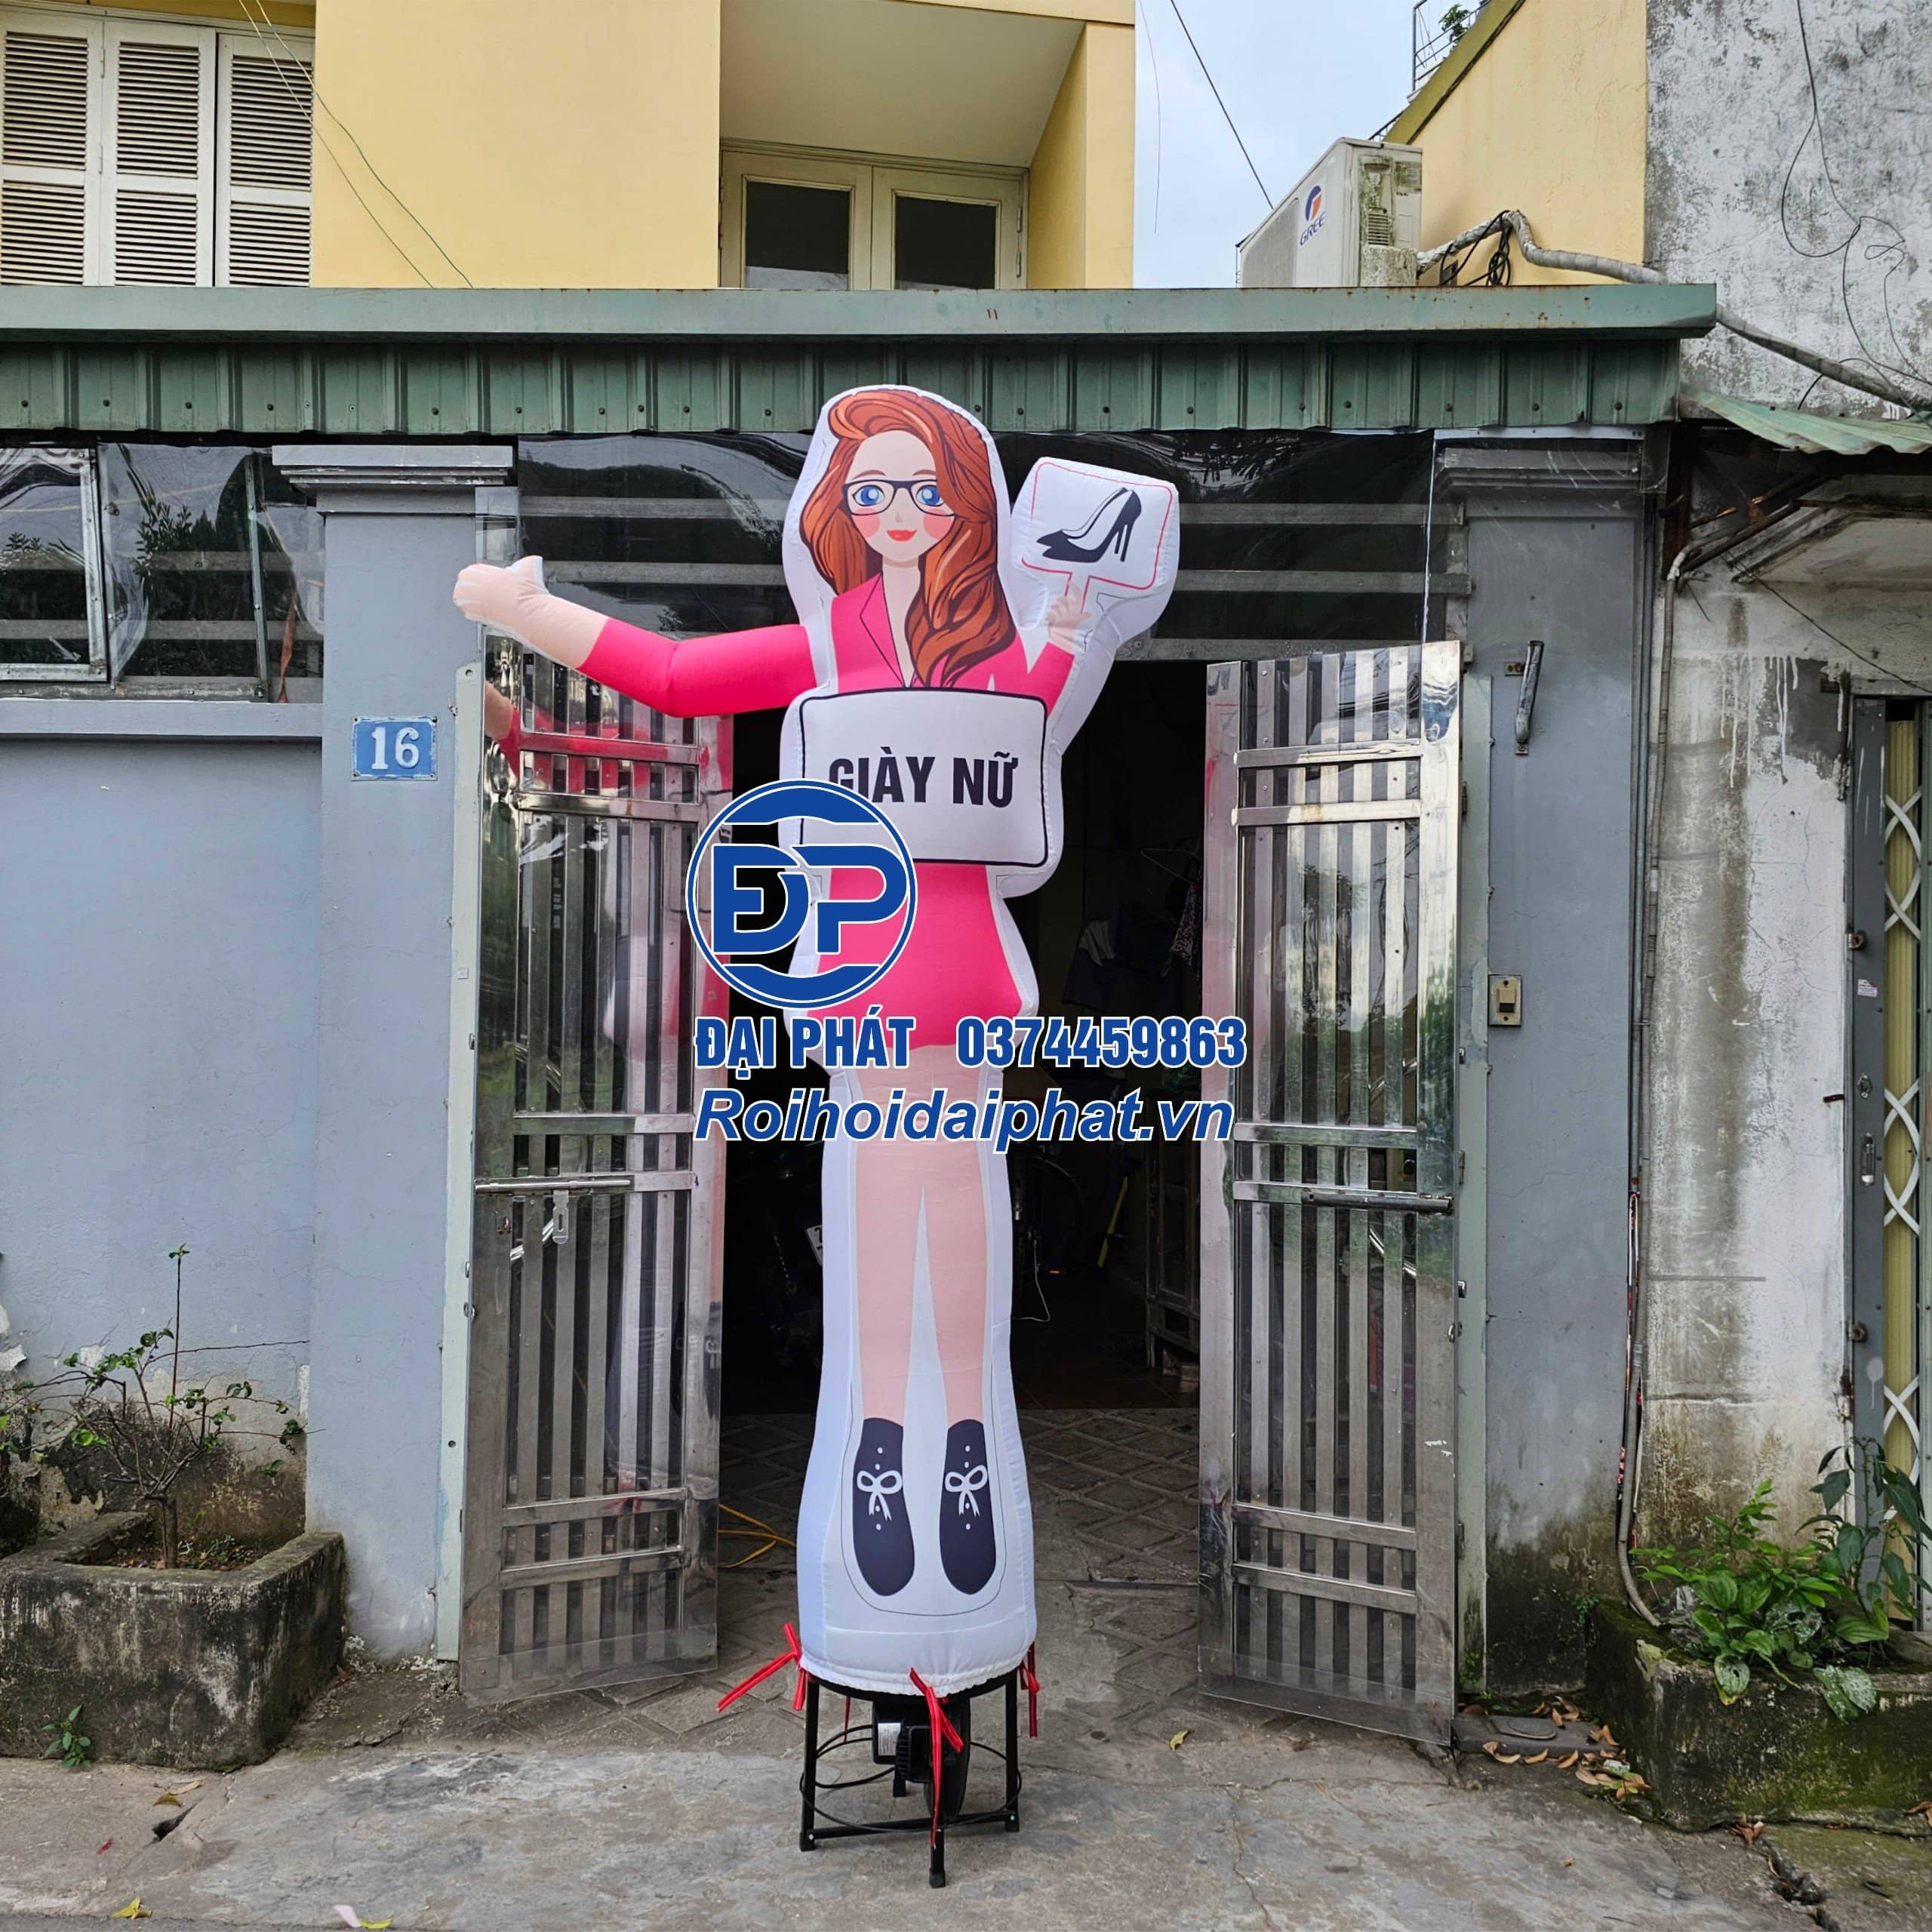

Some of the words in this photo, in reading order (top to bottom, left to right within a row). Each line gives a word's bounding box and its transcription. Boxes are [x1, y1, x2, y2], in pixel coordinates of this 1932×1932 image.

[1300, 211, 1325, 246] GREE
[371, 727, 420, 770] 16
[829, 746, 936, 803] GIÀY
[952, 751, 1018, 808] NỮ
